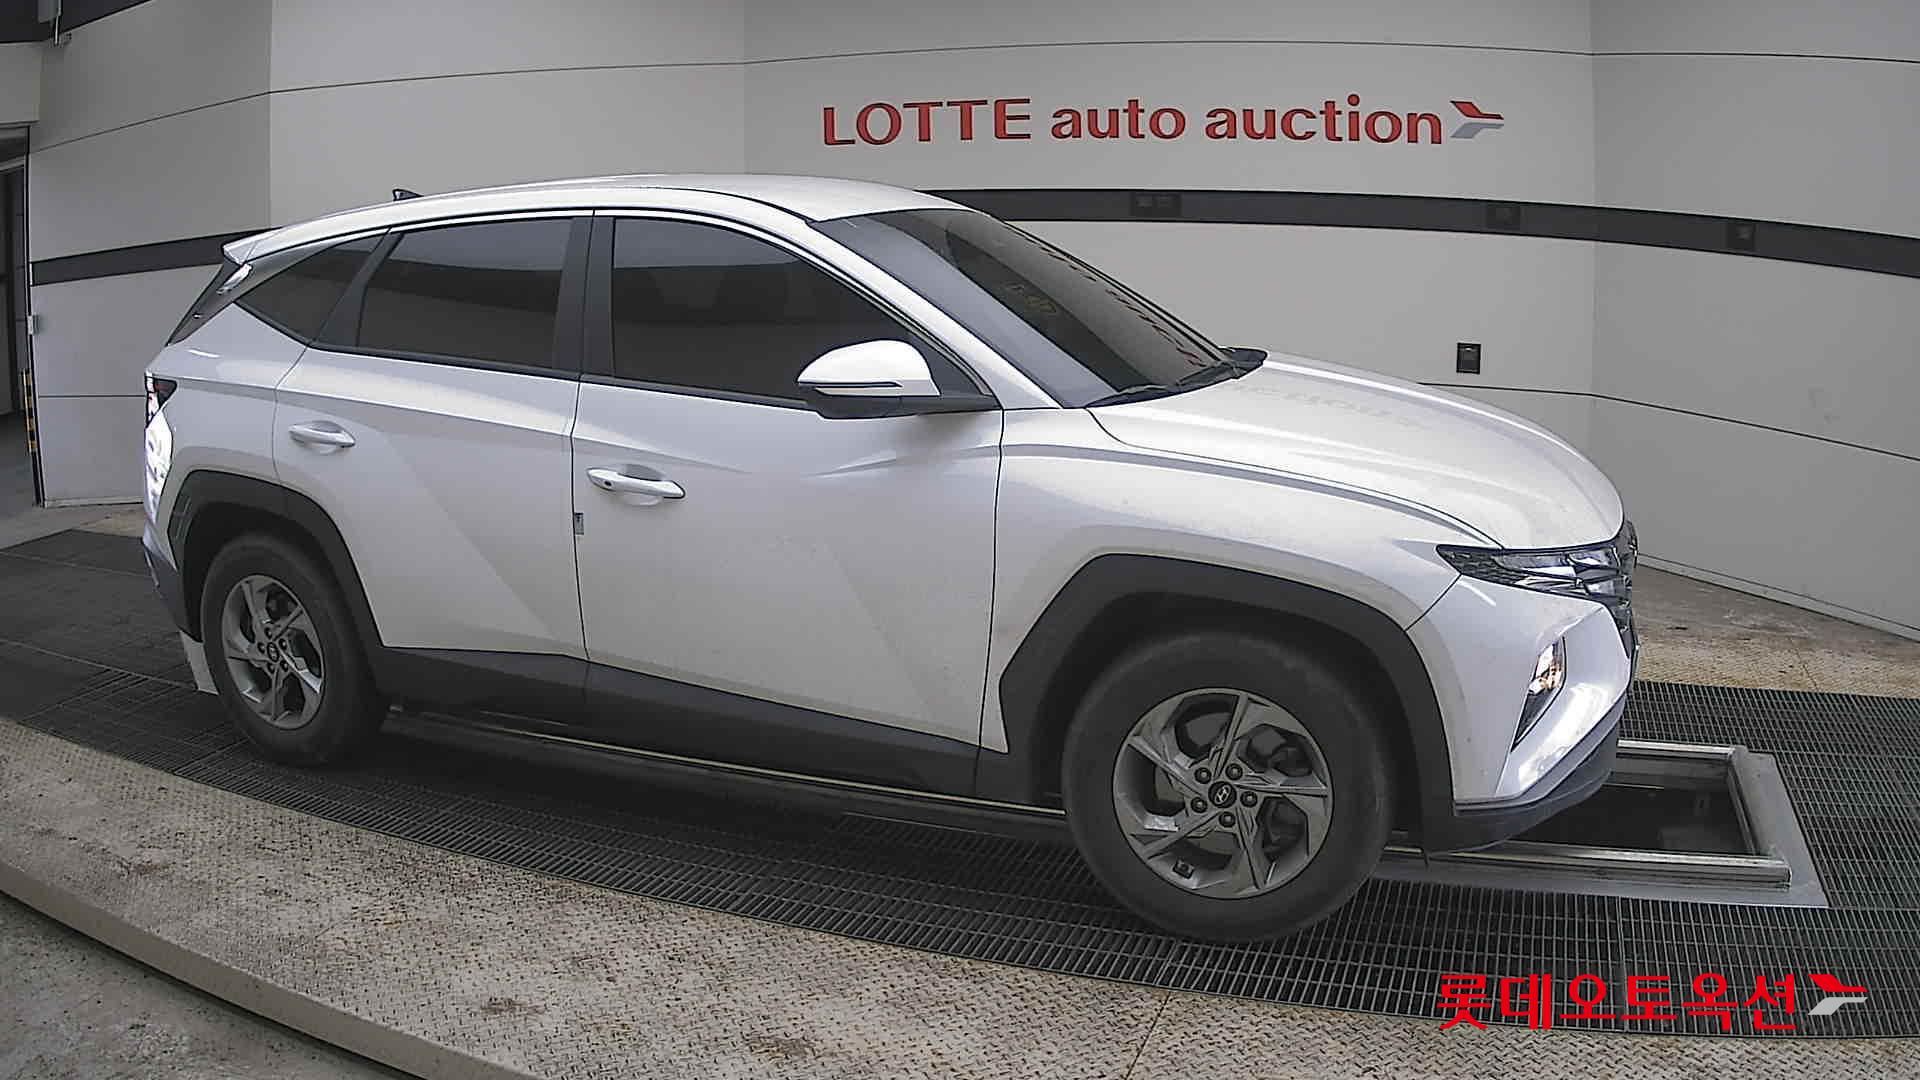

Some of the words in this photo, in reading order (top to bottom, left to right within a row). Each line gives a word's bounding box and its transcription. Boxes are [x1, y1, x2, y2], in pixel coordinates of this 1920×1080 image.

[823, 98, 1031, 145] LOTTE
[1051, 99, 1186, 140] auto
[1205, 94, 1442, 145] auction
